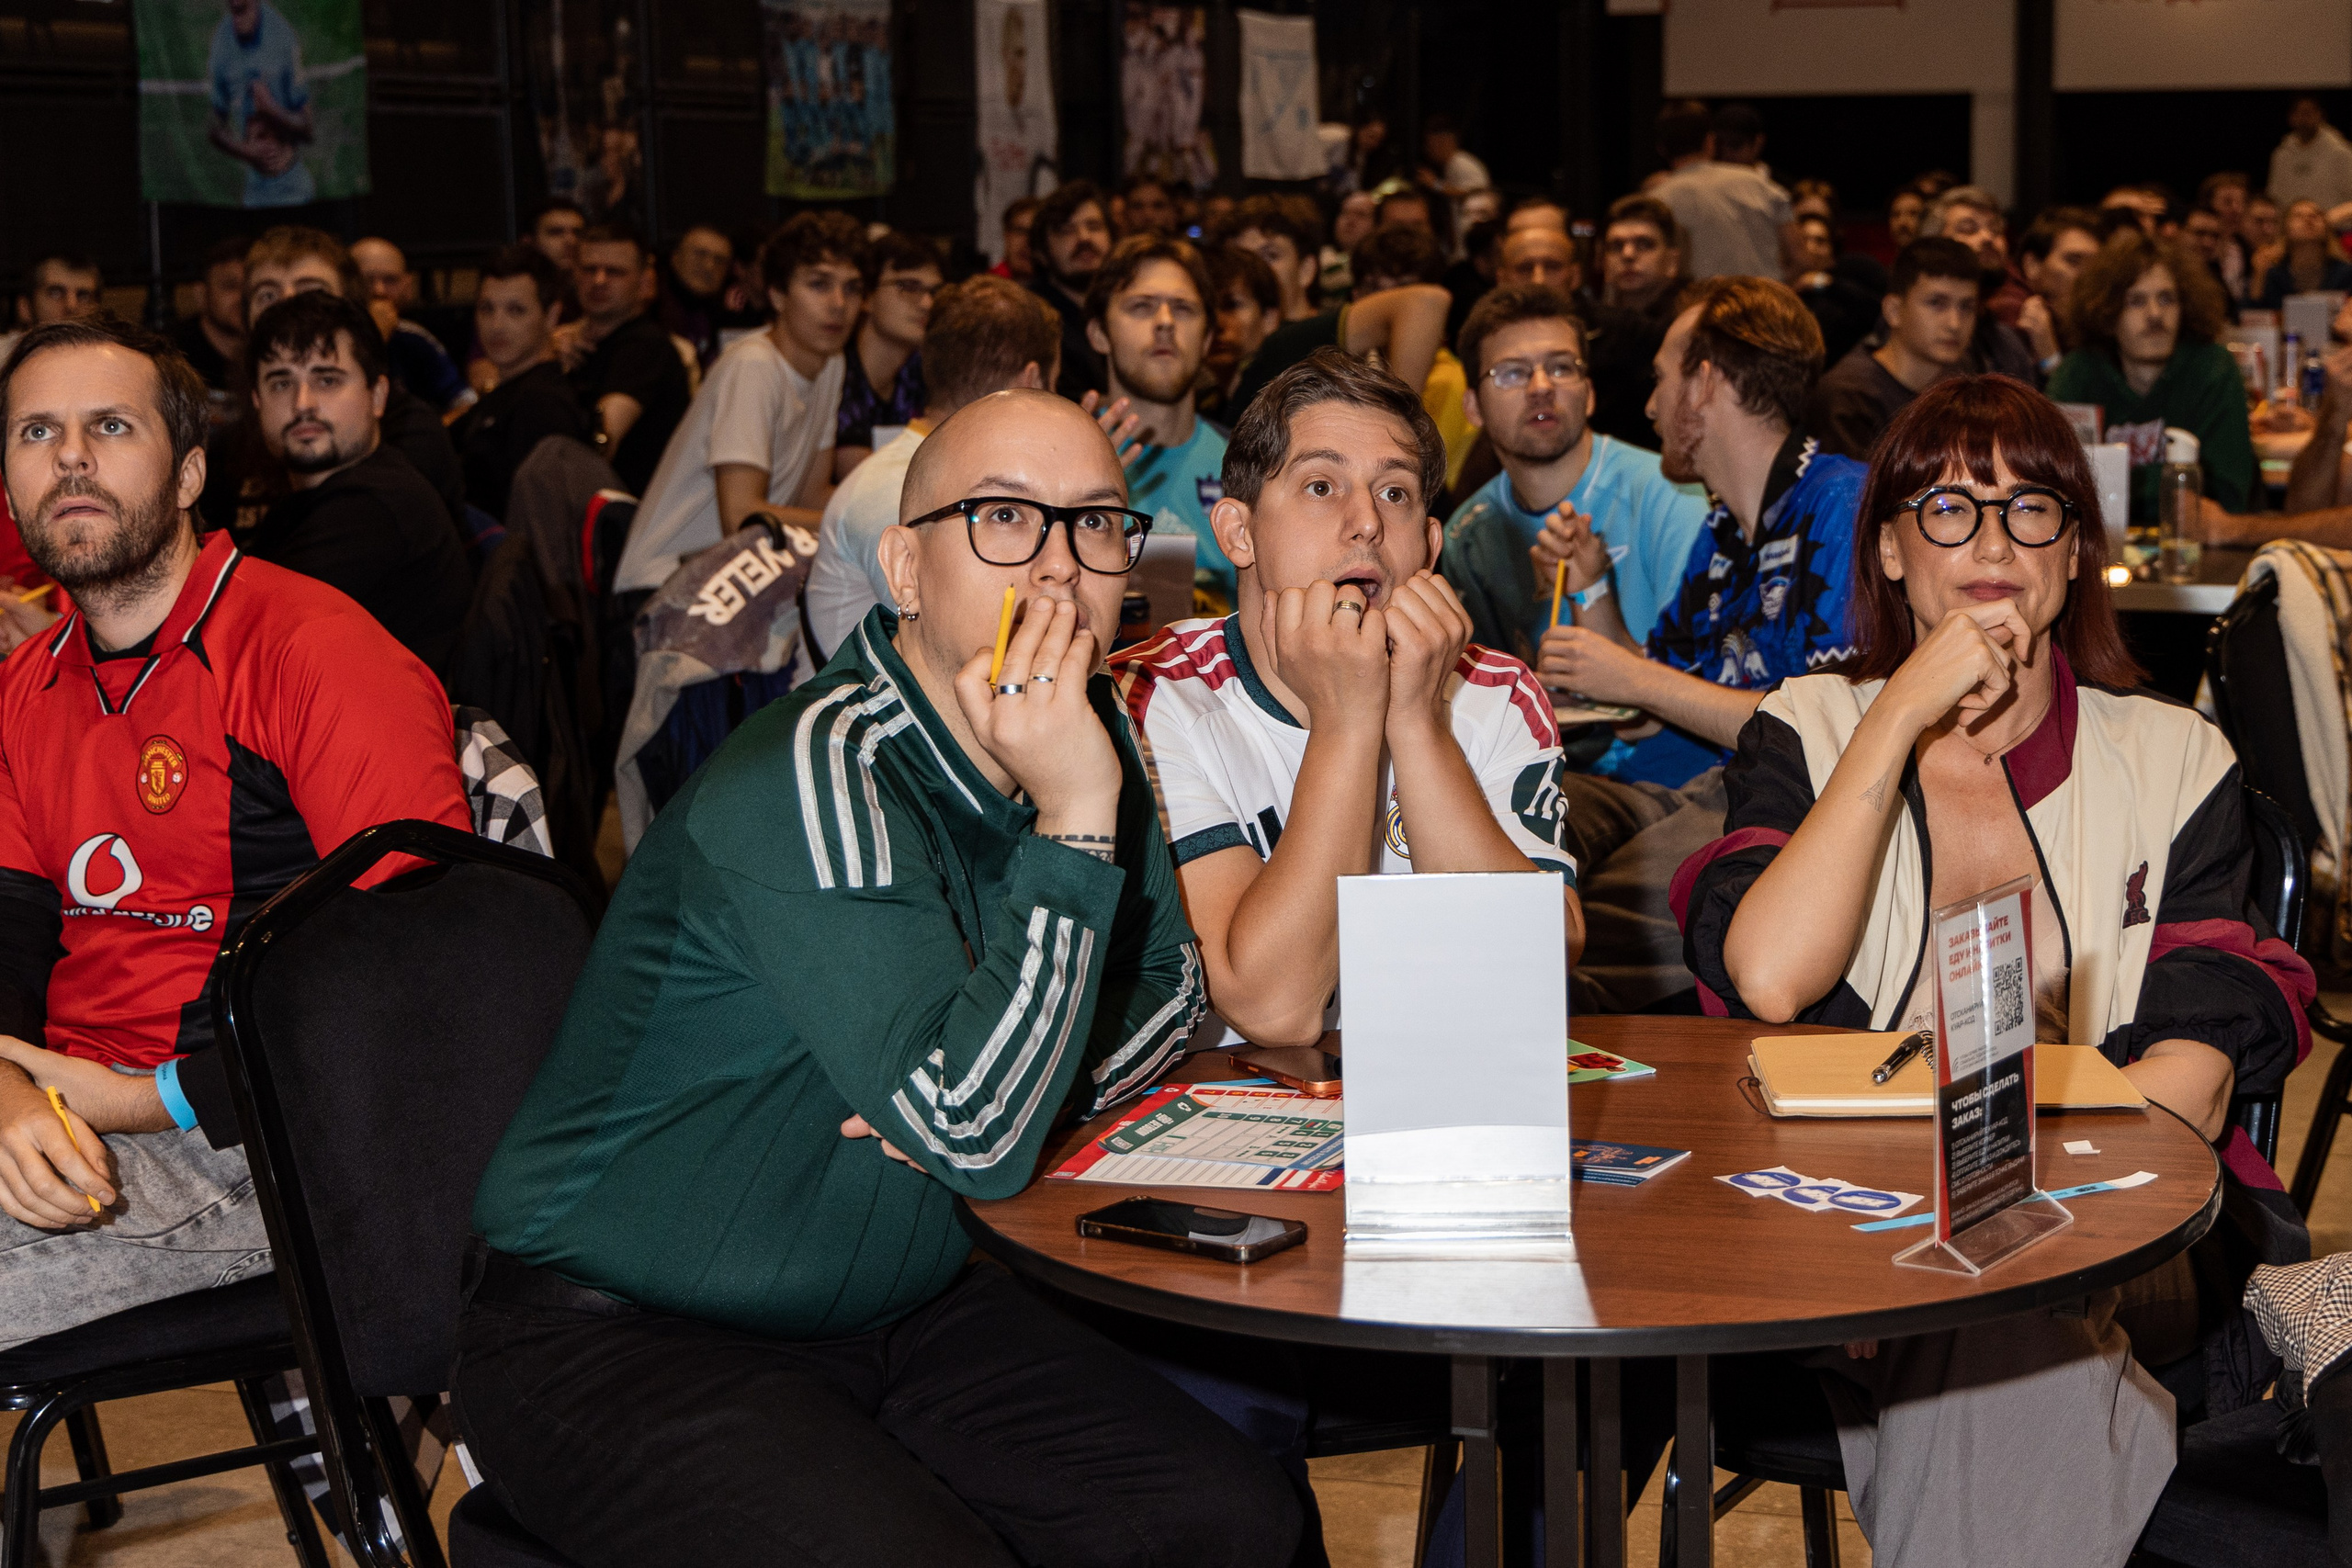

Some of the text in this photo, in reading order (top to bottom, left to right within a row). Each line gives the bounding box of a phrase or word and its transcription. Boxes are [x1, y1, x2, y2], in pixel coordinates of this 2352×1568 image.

[147, 793, 171, 805] UNITED
[1949, 915, 2009, 948] ЗАКАЗЫАЙТЕ
[1973, 931, 2011, 955] НИТКИ
[1951, 1072, 2019, 1112] ЧТОБЫ СДЕЛАТЬ
[1951, 1107, 1983, 1130] ЗАКАЗ:
